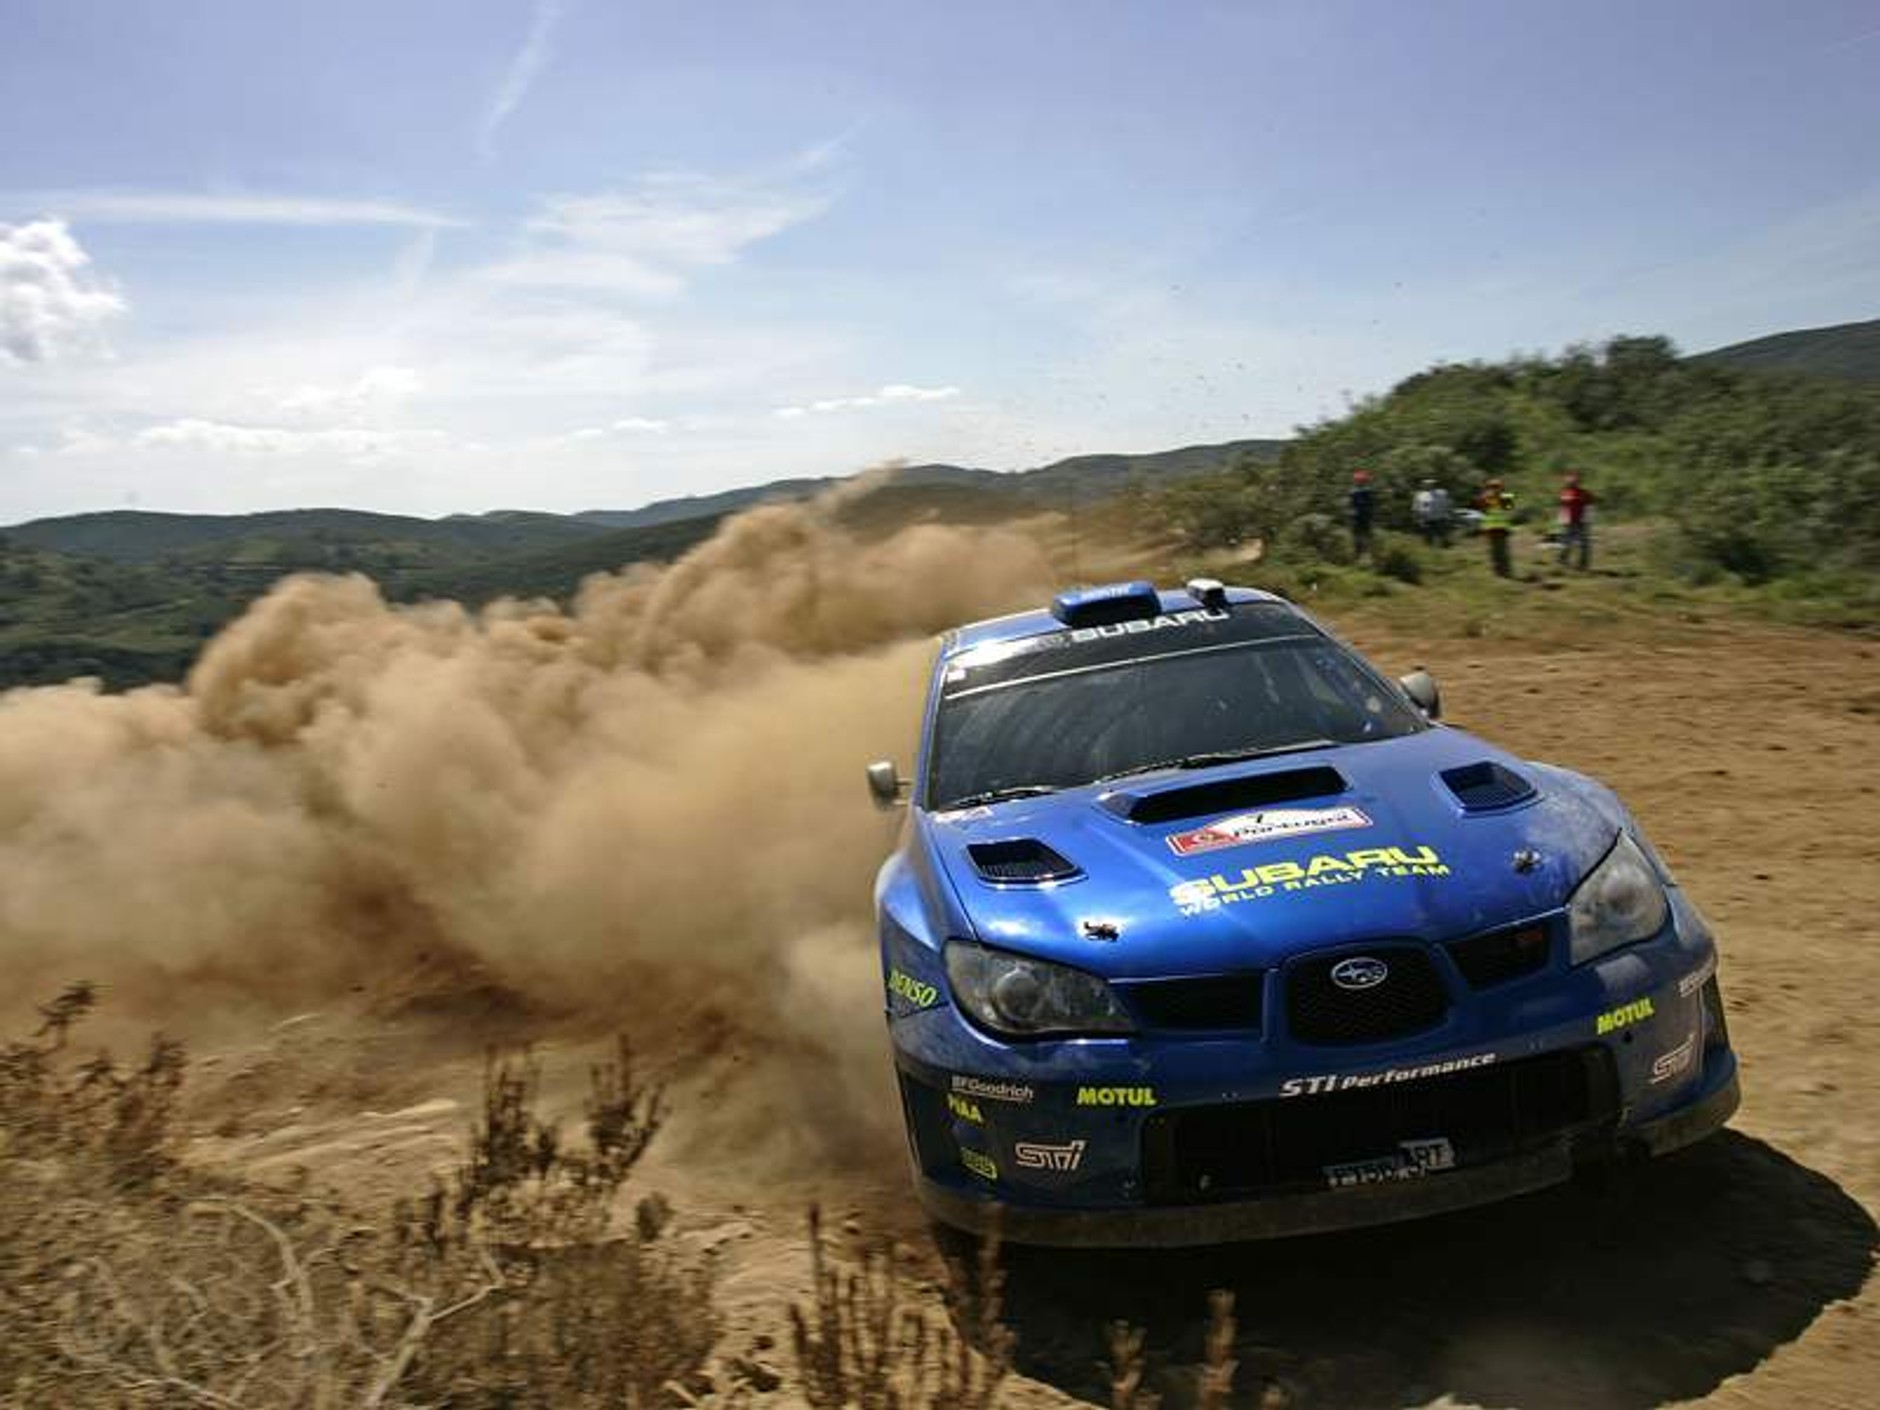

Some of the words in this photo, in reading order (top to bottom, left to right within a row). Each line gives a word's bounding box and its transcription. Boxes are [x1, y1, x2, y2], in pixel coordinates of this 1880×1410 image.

[1071, 607, 1230, 643] SUBARU
[1169, 846, 1440, 906] SUBARU
[1178, 886, 1274, 917] WORLD
[1283, 870, 1362, 892] RALLY
[1376, 862, 1451, 880] TEAM
[1596, 998, 1655, 1035] MOTUL
[1279, 1074, 1335, 1098] STI
[1341, 1052, 1496, 1090] Performance
[1077, 1086, 1157, 1106] MOTUL
